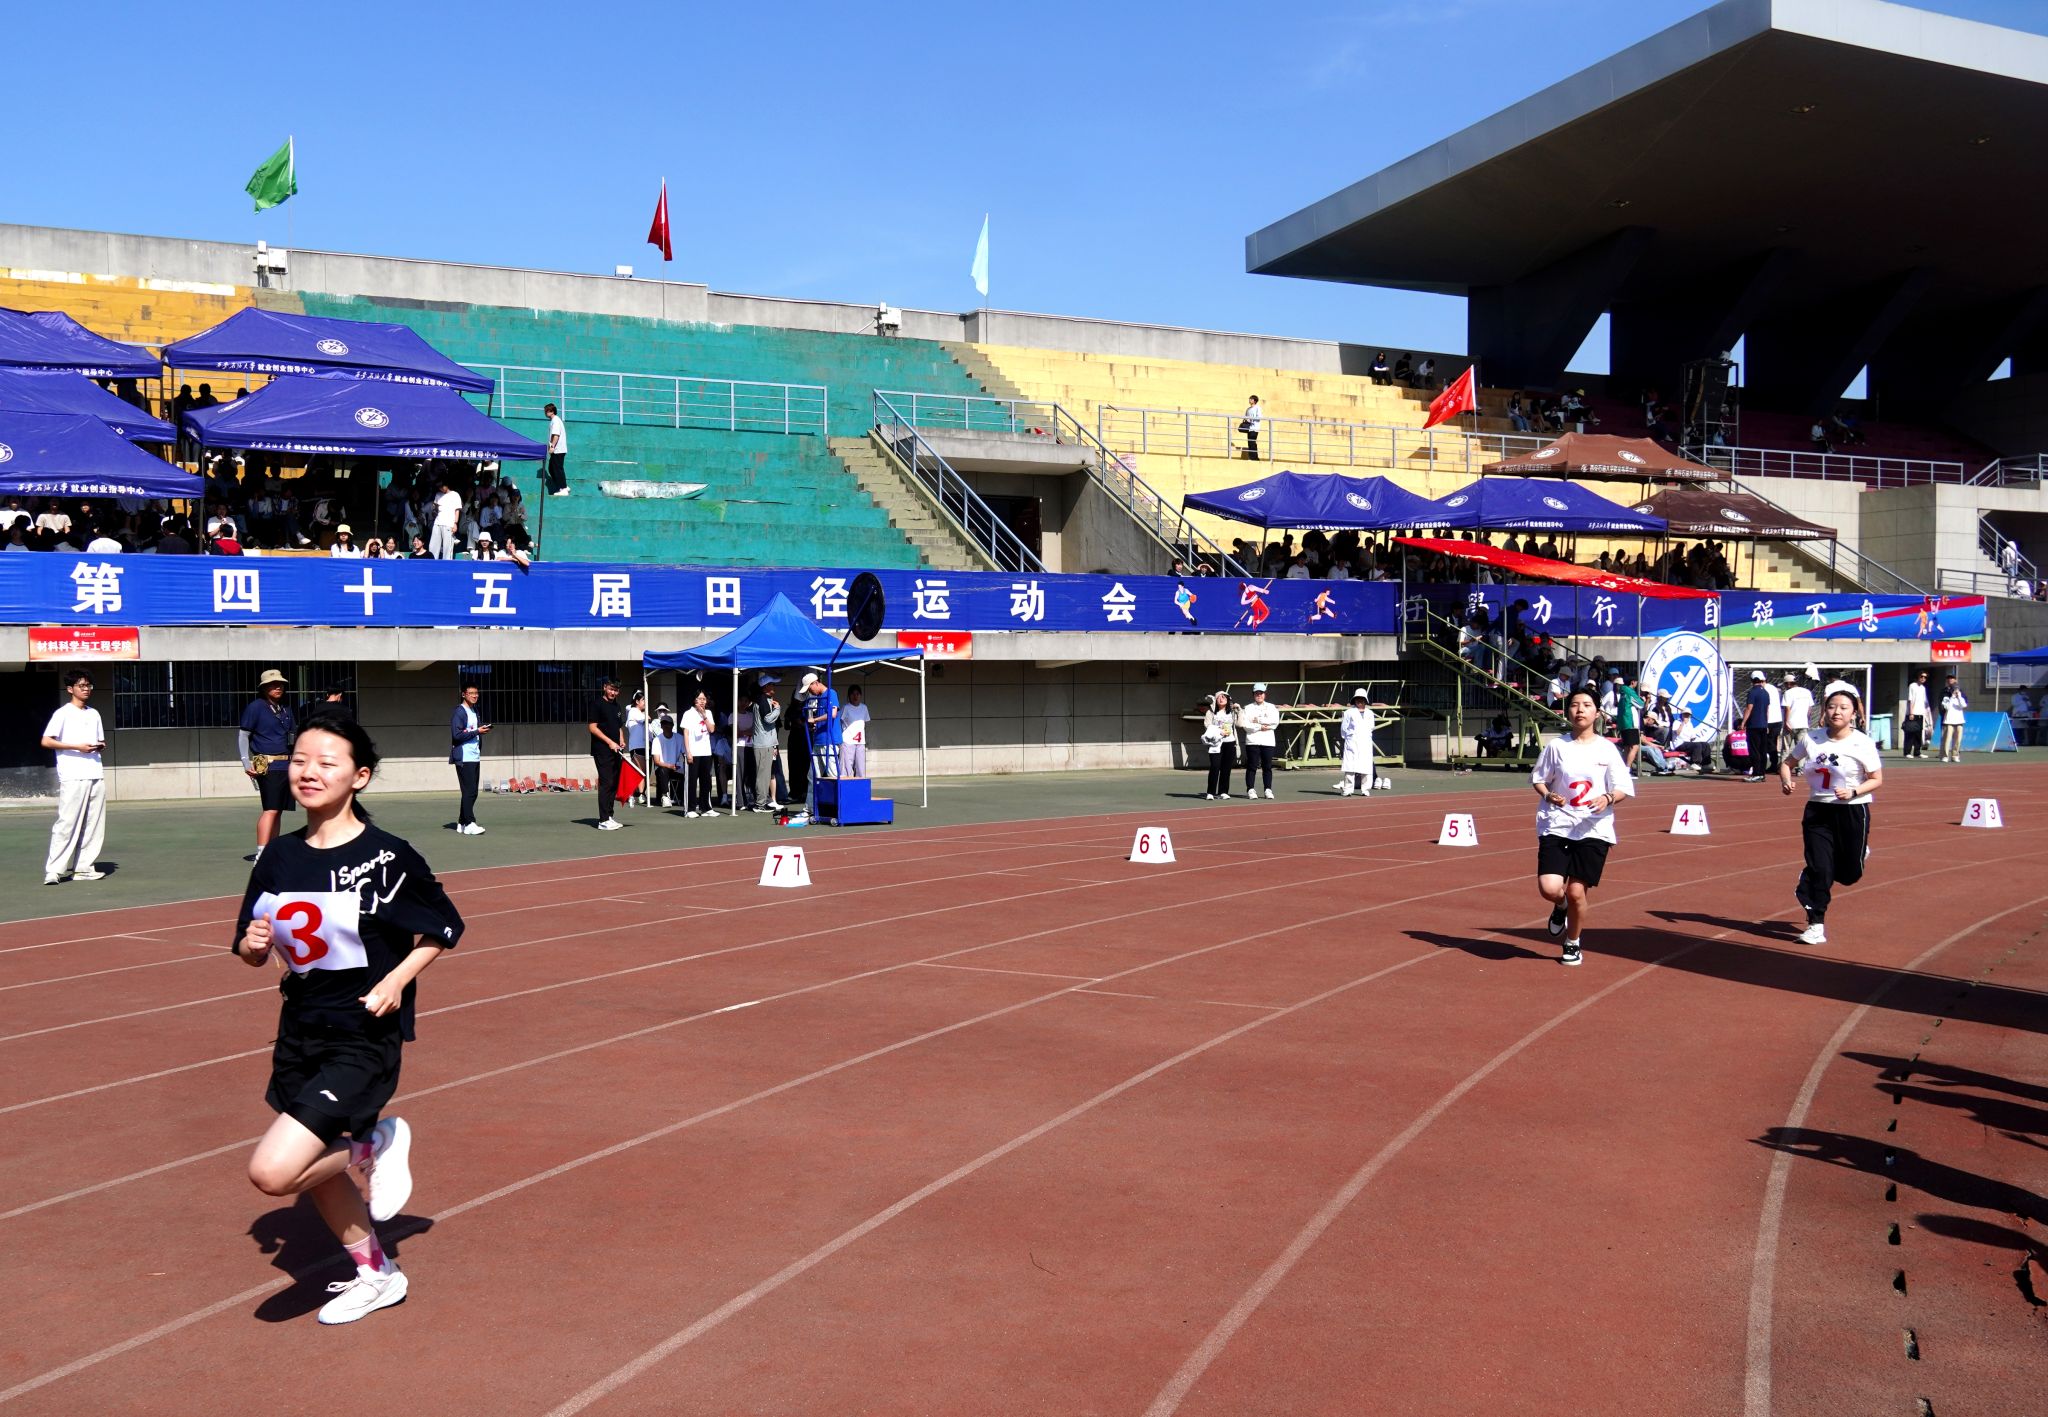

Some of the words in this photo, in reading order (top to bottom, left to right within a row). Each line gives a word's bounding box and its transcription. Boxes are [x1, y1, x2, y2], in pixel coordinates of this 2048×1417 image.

[257, 364, 316, 374] 就业创业指导中心
[440, 449, 499, 459] 就业创业指导中心
[70, 484, 145, 495] 就业创业指导中心
[70, 561, 1137, 623] 第四十五届田径运动会
[37, 640, 132, 652] 材料科学与工程学院
[852, 731, 862, 742] 4
[1569, 780, 1592, 807] 2
[1679, 809, 1689, 826] 4
[1970, 803, 1980, 820] 3
[1990, 804, 1996, 820] 3
[1448, 820, 1458, 838] 5
[1140, 833, 1150, 854] 6
[1160, 834, 1168, 854] 6
[338, 849, 396, 885] Sports
[772, 854, 783, 877] 7
[276, 901, 329, 966] 3
